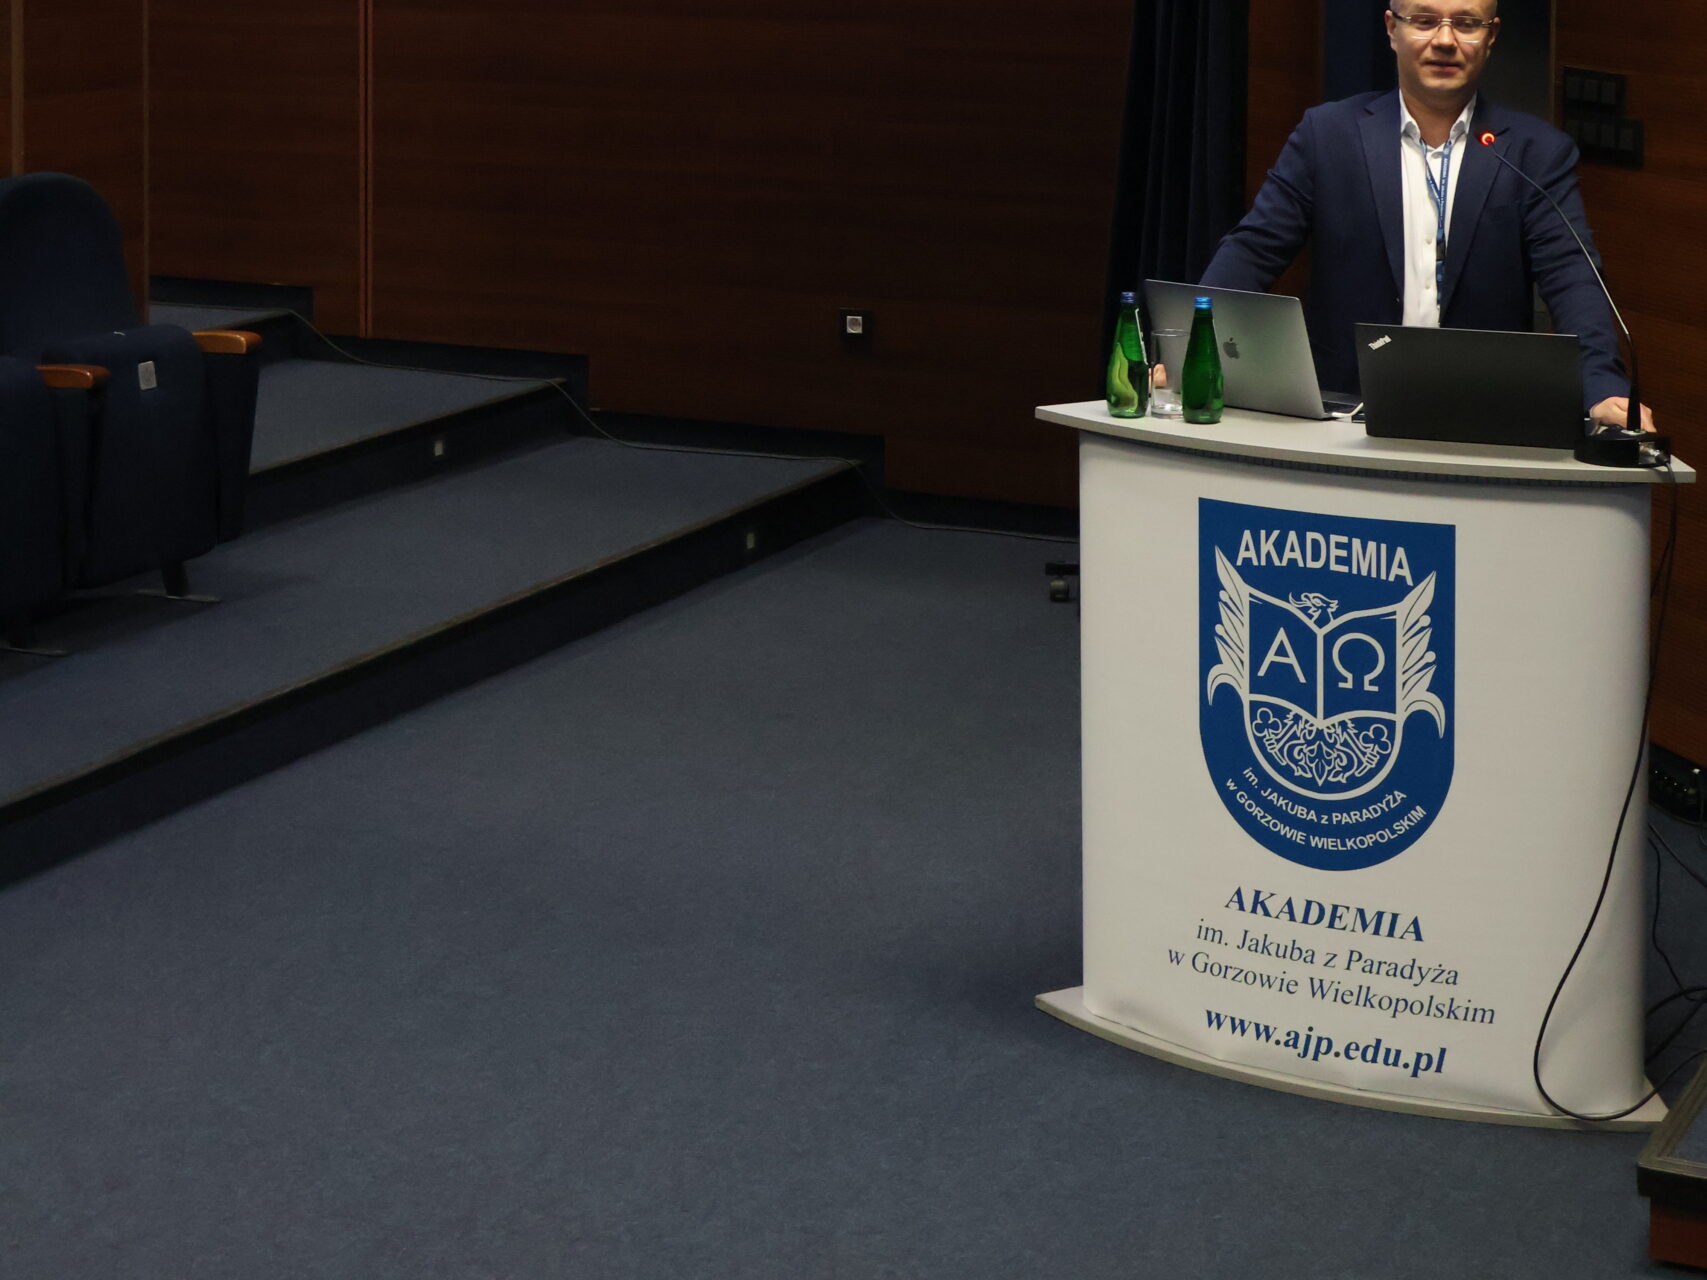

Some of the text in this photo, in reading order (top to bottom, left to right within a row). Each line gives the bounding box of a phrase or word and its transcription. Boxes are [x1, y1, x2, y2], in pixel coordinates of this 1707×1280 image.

[1236, 529, 1414, 587] AKADEMIA
[1332, 632, 1385, 692] Ω
[1225, 778, 1427, 851] w GORZOWIE WIELKOPOLSKIM
[1242, 766, 1407, 825] im. JAKUBA z PARADYŻA
[1225, 886, 1425, 942] AKADEMIA
[1196, 918, 1459, 987] im. Jakuba z Paradyża
[1168, 949, 1496, 1024] w Gorzowie Wielkopolskim
[1205, 1009, 1447, 1078] www.ajp.edu.pl
